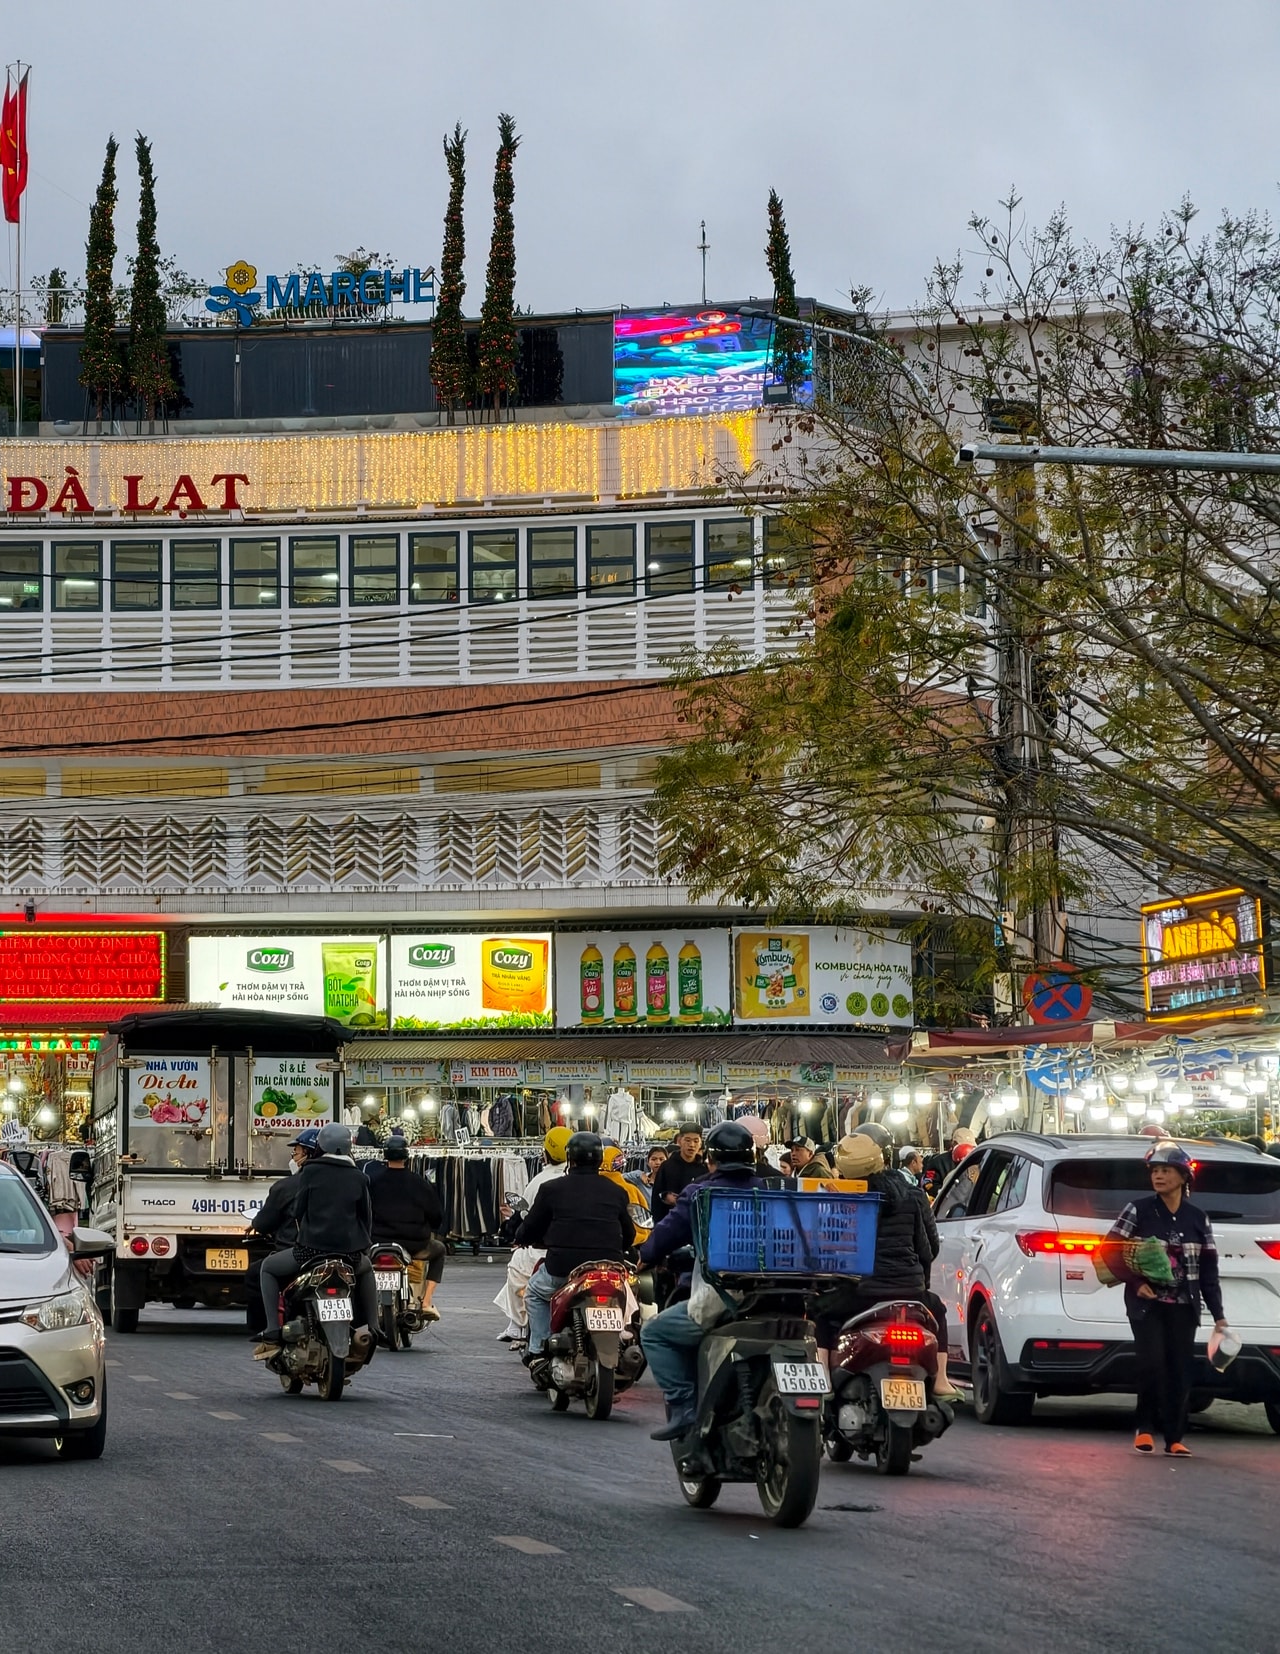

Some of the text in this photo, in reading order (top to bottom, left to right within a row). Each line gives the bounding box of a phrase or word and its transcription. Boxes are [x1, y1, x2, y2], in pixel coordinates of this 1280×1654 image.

[7, 466, 95, 512] ĐÀ
[122, 473, 250, 519] LẠT
[67, 936, 96, 949] QUY
[250, 951, 290, 968] Cozy
[413, 947, 451, 963] Cozy
[494, 951, 528, 968] Cozy
[754, 952, 795, 967] Kombucha
[815, 962, 871, 972] KOMBUCHA
[893, 963, 908, 973] TAN
[236, 982, 259, 991] THƠM
[280, 982, 288, 992] VỊ
[289, 982, 305, 991] TRÀ
[399, 978, 421, 987] THƠM
[442, 978, 449, 988] VỊ
[451, 978, 466, 987] TRÀ
[232, 992, 246, 1001] HÀI
[247, 992, 264, 1001] HÒA
[266, 993, 285, 1003] NHỊP
[394, 988, 408, 997] HÀI
[409, 988, 426, 997] HÒA
[427, 989, 447, 999] NHỊP
[328, 994, 359, 1007] MATCHA
[146, 1059, 198, 1072] NHÀ VƯỜN
[289, 1064, 295, 1073] &
[471, 1067, 518, 1077] KIM THOA
[837, 1071, 868, 1081] MINH
[254, 1075, 330, 1087] TRÁI CÂY NÔNG SẢN
[270, 1118, 311, 1127] 0936.817
[218, 1251, 236, 1259] 49H
[211, 1260, 243, 1268] 015.91
[323, 1299, 346, 1310] 49-E1
[321, 1310, 351, 1320] 673.98
[592, 1310, 617, 1320] 49-B1
[590, 1320, 622, 1330] 595.50
[783, 1363, 818, 1377] 49-AA
[782, 1378, 826, 1392] 150.68
[888, 1382, 917, 1395] 49-B1
